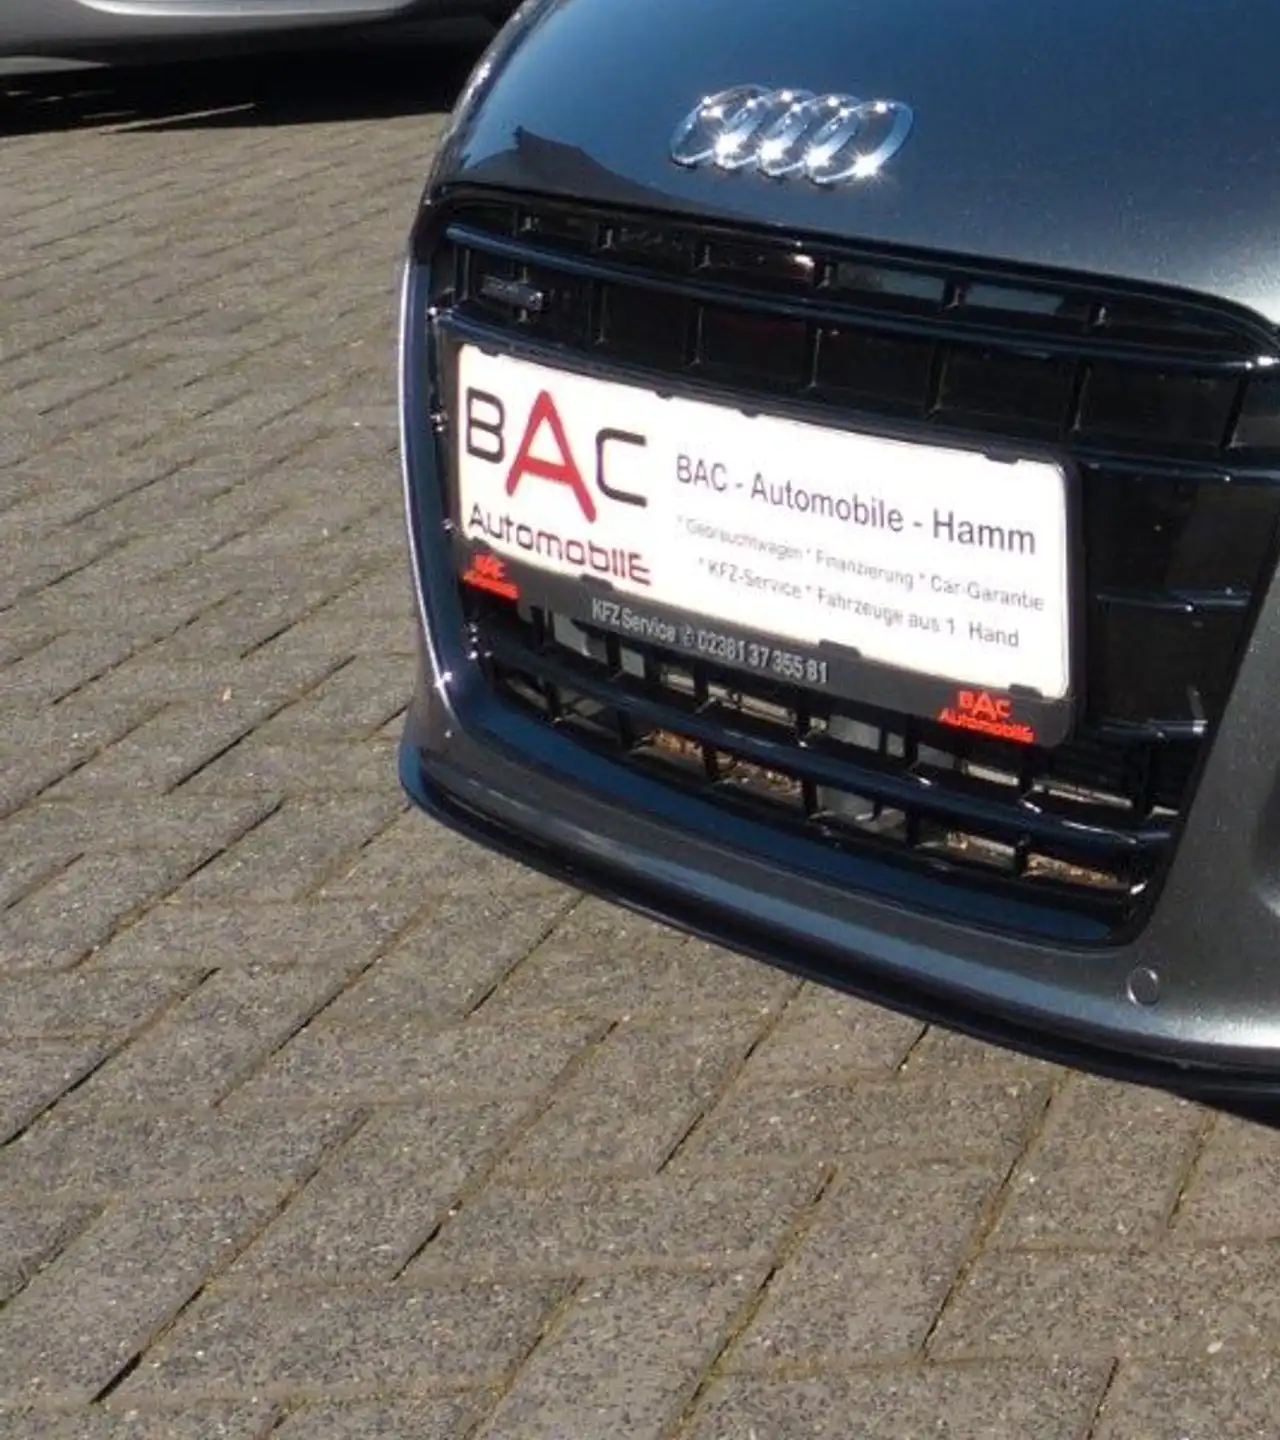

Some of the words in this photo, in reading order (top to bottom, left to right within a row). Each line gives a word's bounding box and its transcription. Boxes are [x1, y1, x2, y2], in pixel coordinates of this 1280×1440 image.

[466, 385, 649, 524] BAC
[676, 453, 728, 493] BAC
[750, 471, 904, 533] Automobile
[932, 507, 1036, 556] Hamm
[591, 597, 621, 627] KFZ
[621, 606, 677, 644] Service
[968, 620, 1020, 648] Hand
